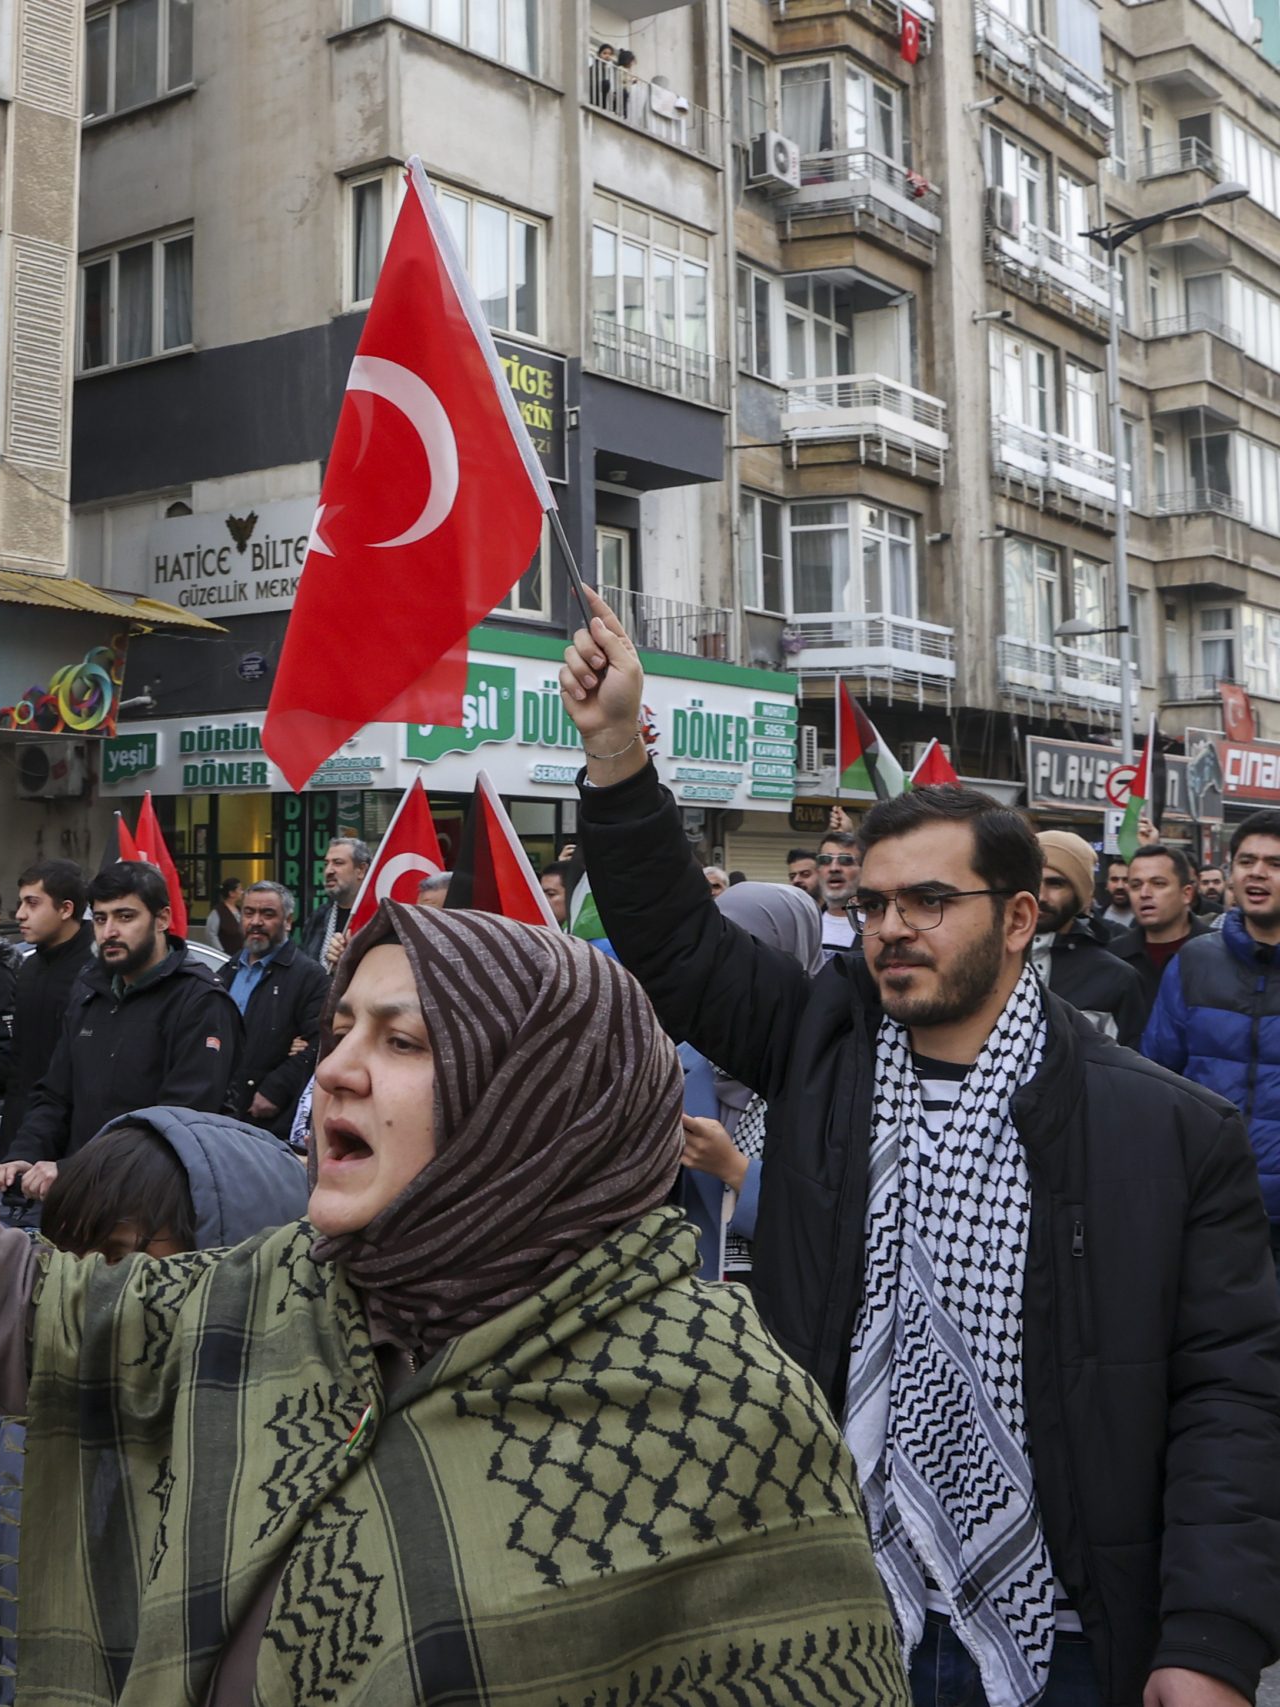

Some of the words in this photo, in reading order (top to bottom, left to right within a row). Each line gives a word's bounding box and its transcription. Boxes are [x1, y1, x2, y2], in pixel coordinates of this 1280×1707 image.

[178, 579, 248, 608] GÜZELLİK
[673, 698, 750, 764] DÖNER
[107, 742, 149, 773] yeşil
[183, 758, 269, 787] DÖNER
